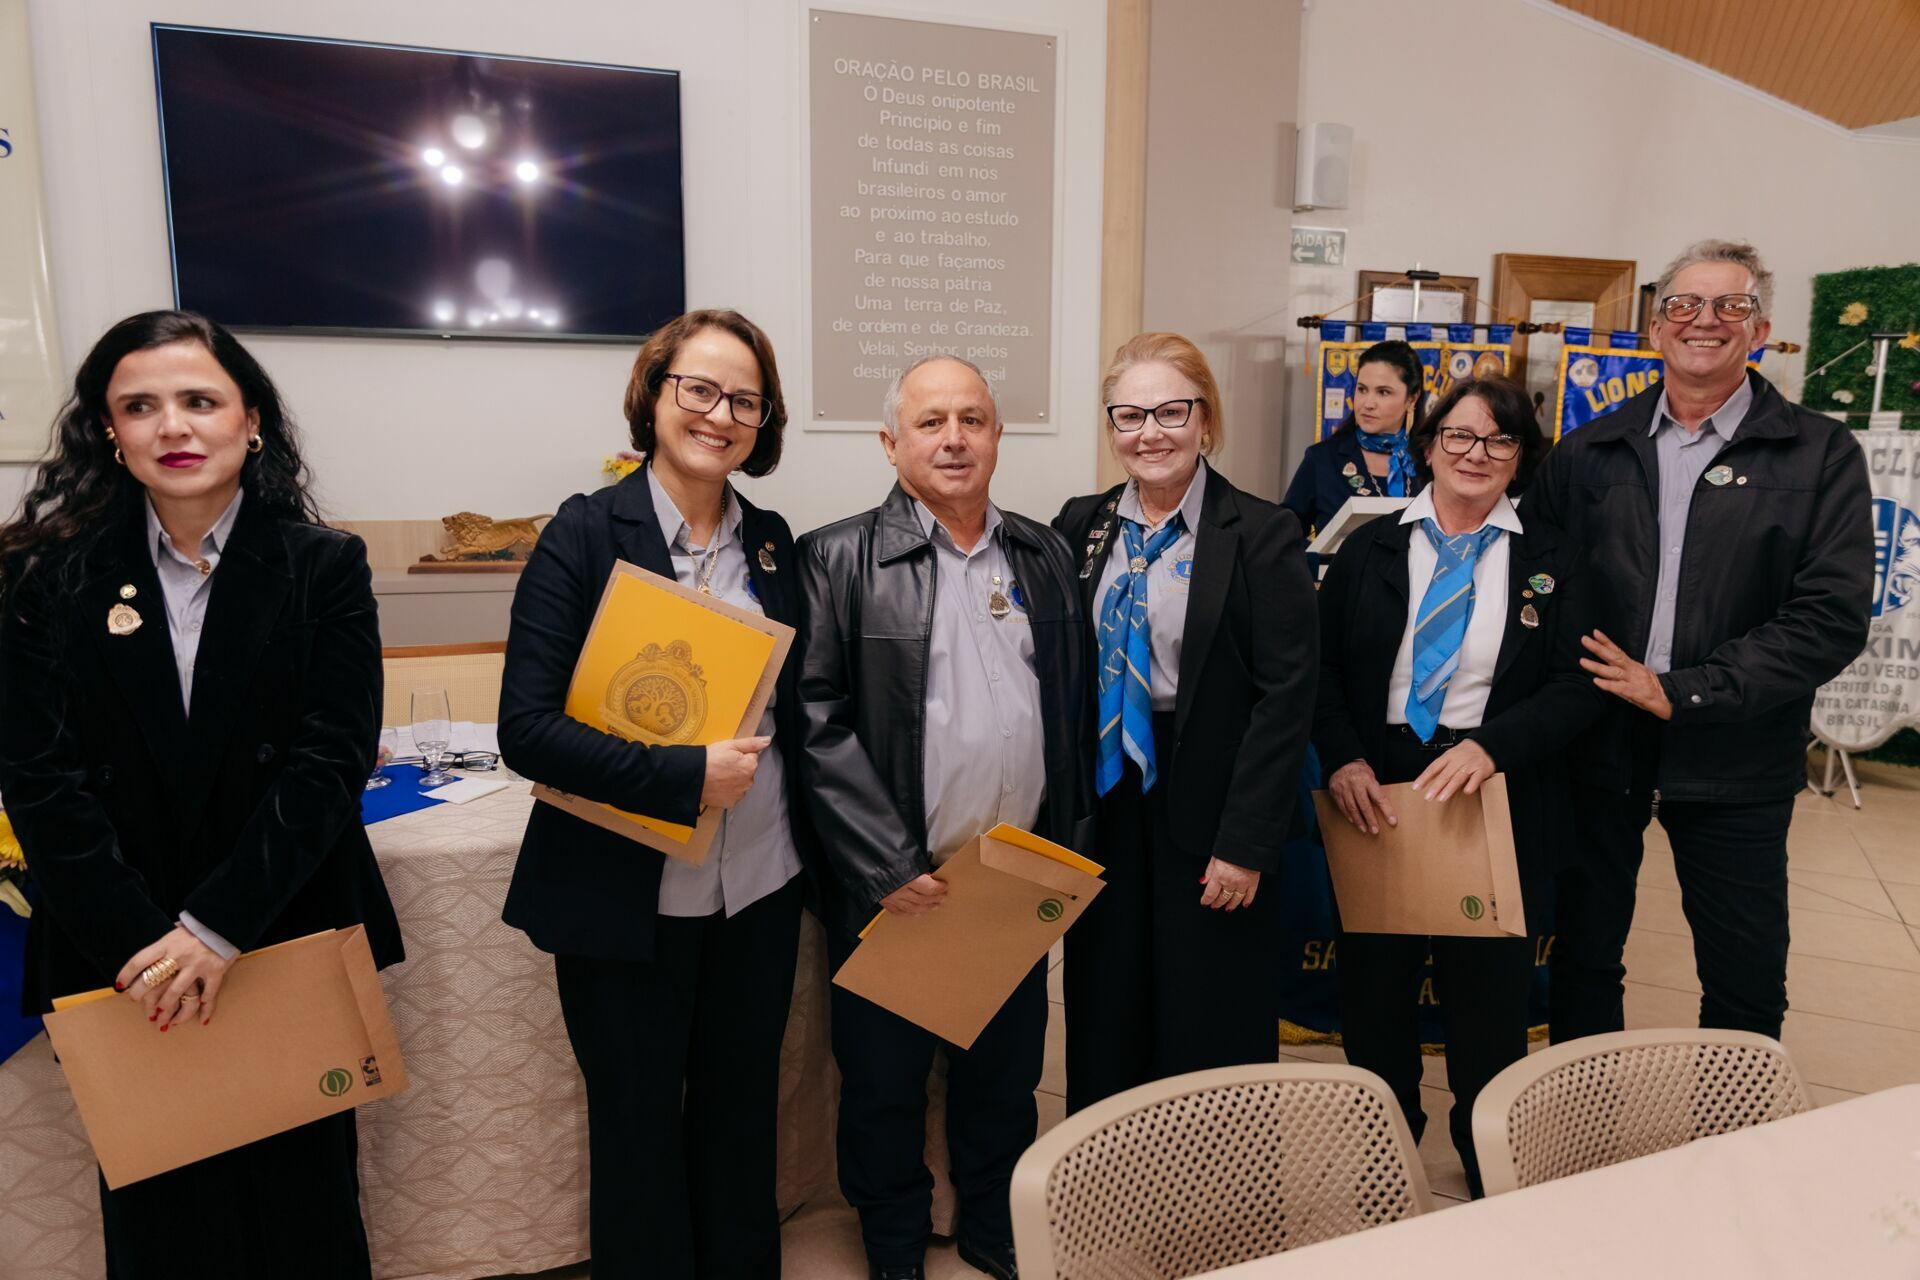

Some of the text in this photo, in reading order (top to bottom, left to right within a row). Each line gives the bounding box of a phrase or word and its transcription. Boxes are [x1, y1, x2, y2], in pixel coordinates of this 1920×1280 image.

[834, 58, 1040, 93] ORAÇÃO PELO BRASIL
[883, 87, 925, 106] Deus
[931, 93, 1016, 114] onipotente
[958, 121, 968, 133] e
[976, 118, 1001, 135] fim
[858, 133, 1015, 160] de todas as coisas
[872, 157, 929, 176] Infundi
[938, 164, 963, 178] em
[858, 180, 1007, 203] brasileiros o amor
[840, 206, 861, 218] ao
[942, 211, 962, 224] ao
[965, 211, 1019, 226] estudo
[875, 231, 886, 242] e
[894, 231, 915, 244] ao
[855, 249, 1006, 272] Para que façamos
[864, 272, 886, 288] de
[891, 275, 939, 290] nossa
[855, 296, 1007, 316] Uma terra de Paz,
[832, 318, 1034, 337] de ordem e de Grandeza.
[967, 343, 1009, 360] pelos
[853, 363, 1006, 381] destin asil
[1874, 663, 1920, 680] VERD
[1823, 682, 1870, 694] STRITO
[1826, 714, 1884, 730] BRASIL
